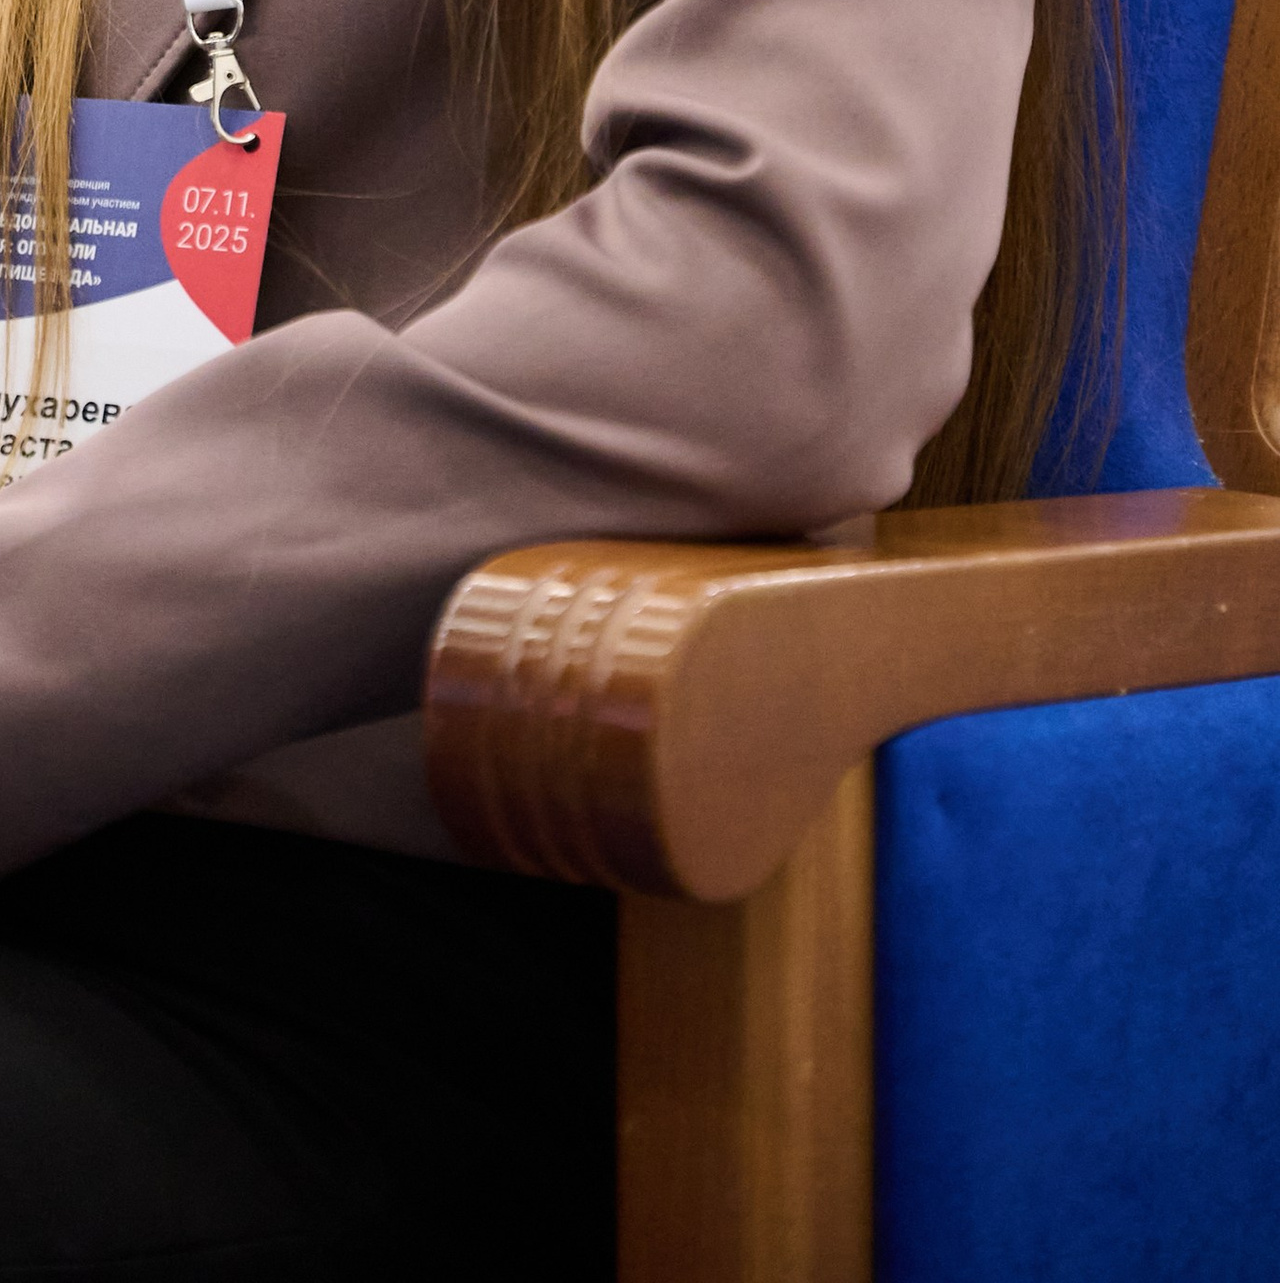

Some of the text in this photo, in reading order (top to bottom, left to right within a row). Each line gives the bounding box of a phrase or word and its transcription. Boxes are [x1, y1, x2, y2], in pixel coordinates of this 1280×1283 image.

[91, 198, 141, 211] участием
[183, 186, 255, 218] 07.11.
[177, 222, 250, 253] 2025
